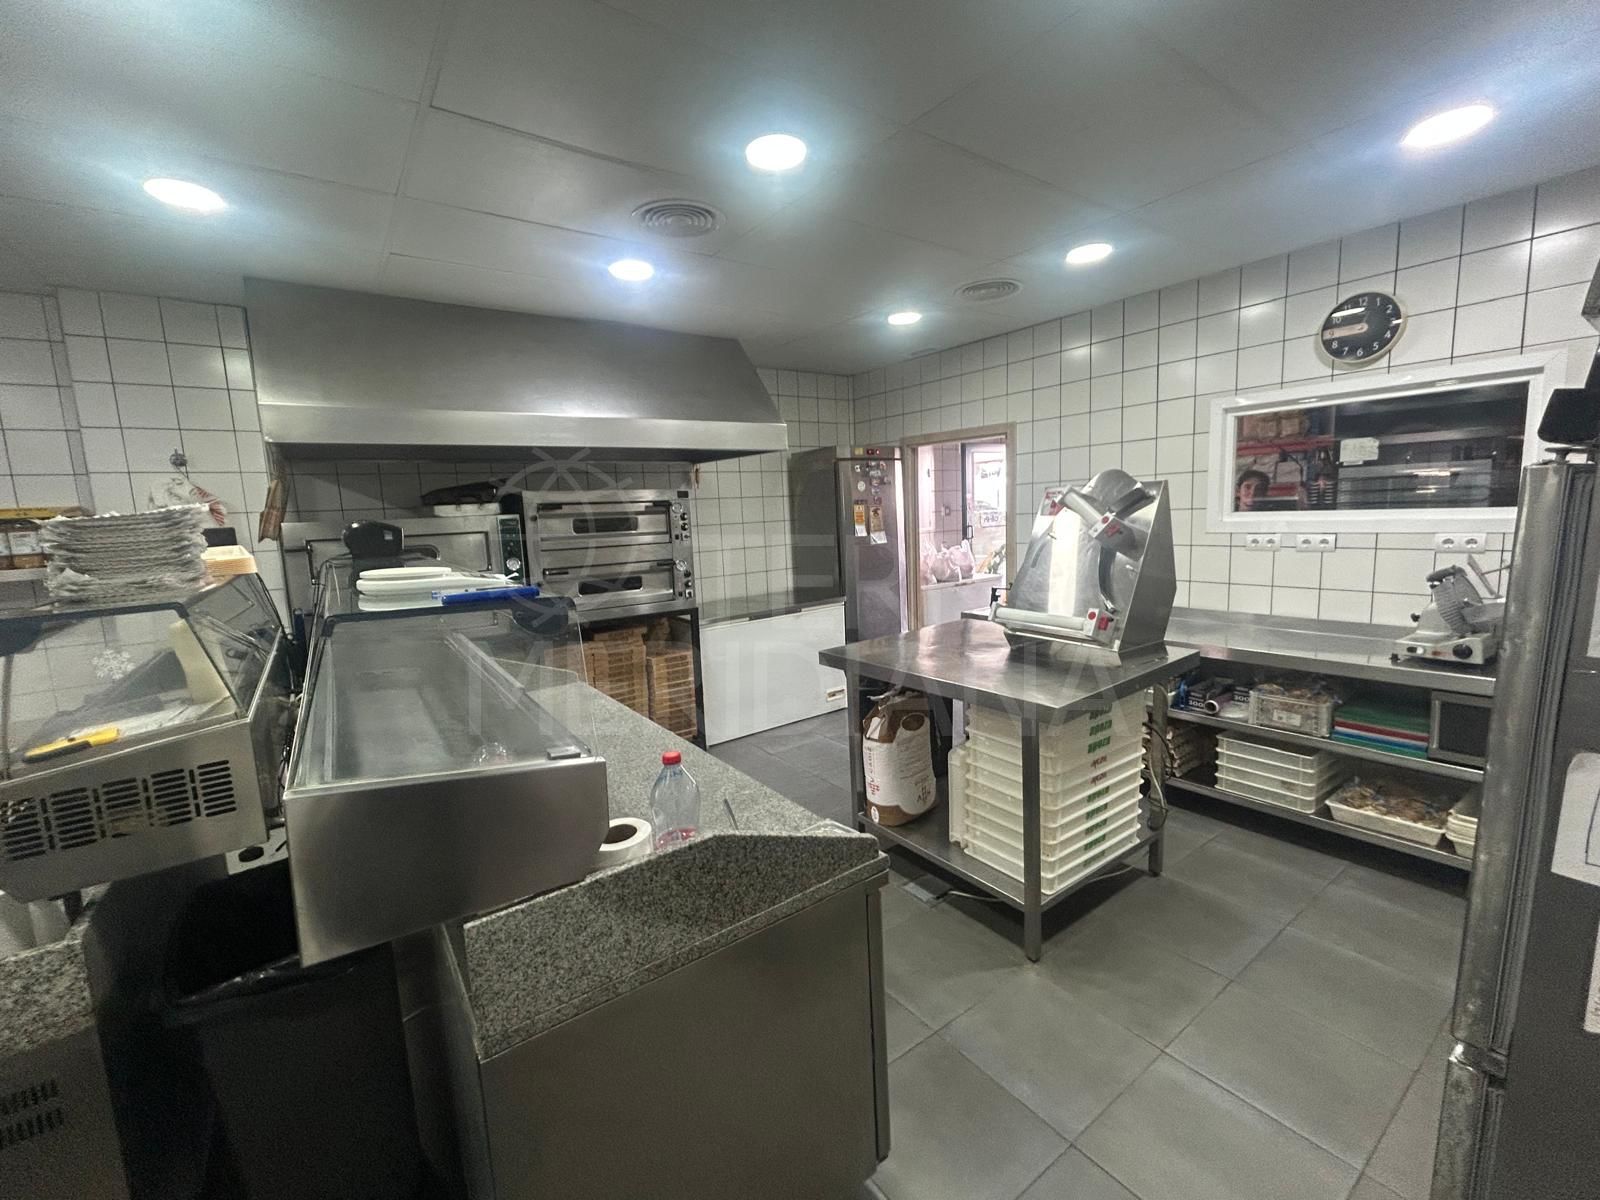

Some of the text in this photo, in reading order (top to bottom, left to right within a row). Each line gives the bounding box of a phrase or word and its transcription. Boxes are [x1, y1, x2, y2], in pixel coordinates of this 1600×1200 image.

[1359, 297, 1368, 306] 12
[1386, 305, 1392, 313] 2
[1384, 330, 1391, 338] 4
[1332, 341, 1338, 349] 8
[1372, 342, 1379, 350] 5
[1342, 347, 1348, 355] 7
[1357, 348, 1363, 356] 6
